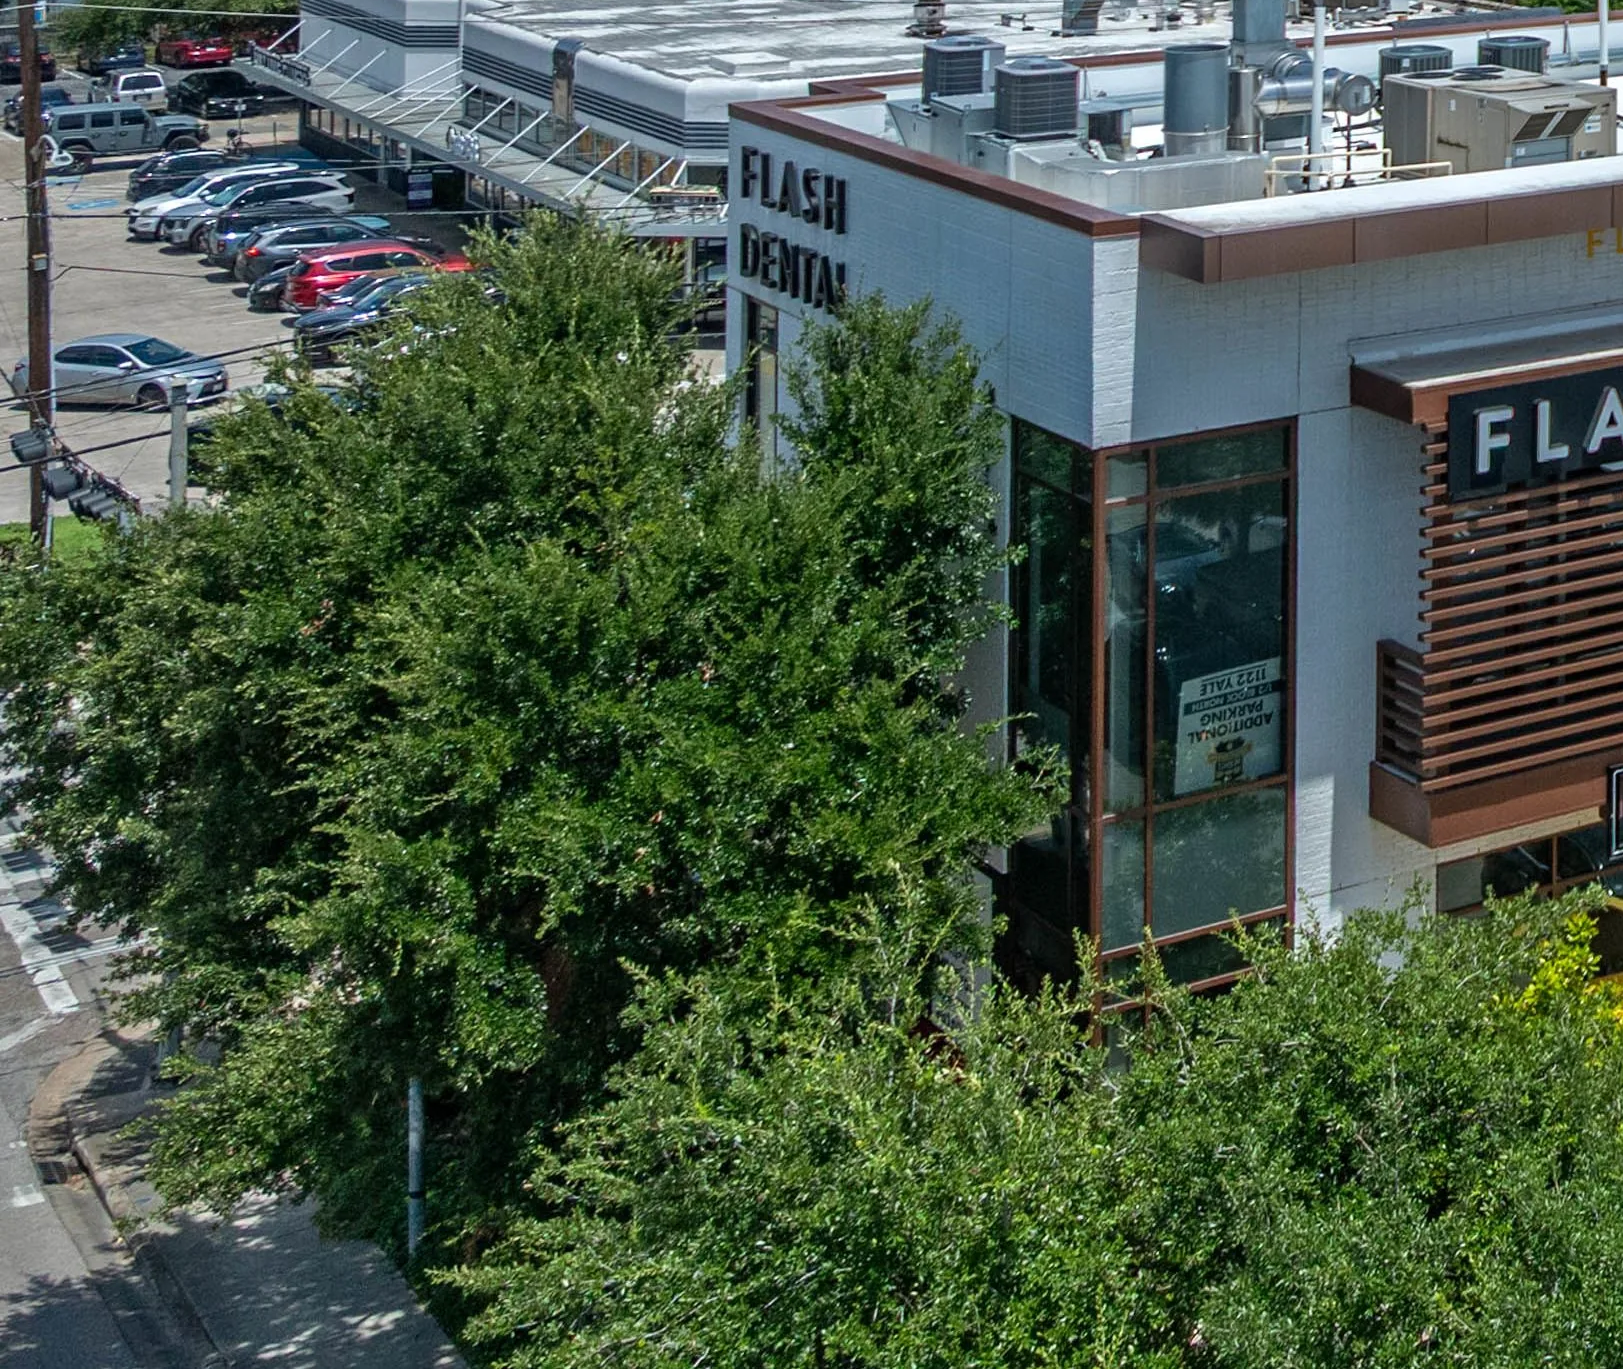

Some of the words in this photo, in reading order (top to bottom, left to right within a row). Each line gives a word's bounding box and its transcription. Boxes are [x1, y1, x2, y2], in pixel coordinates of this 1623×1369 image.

[741, 146, 846, 235] FLASH
[1200, 676, 1235, 697] YALE
[1236, 667, 1267, 685] 1122
[1200, 698, 1264, 727] PARKING
[1187, 711, 1274, 744] ADDITIONAL
